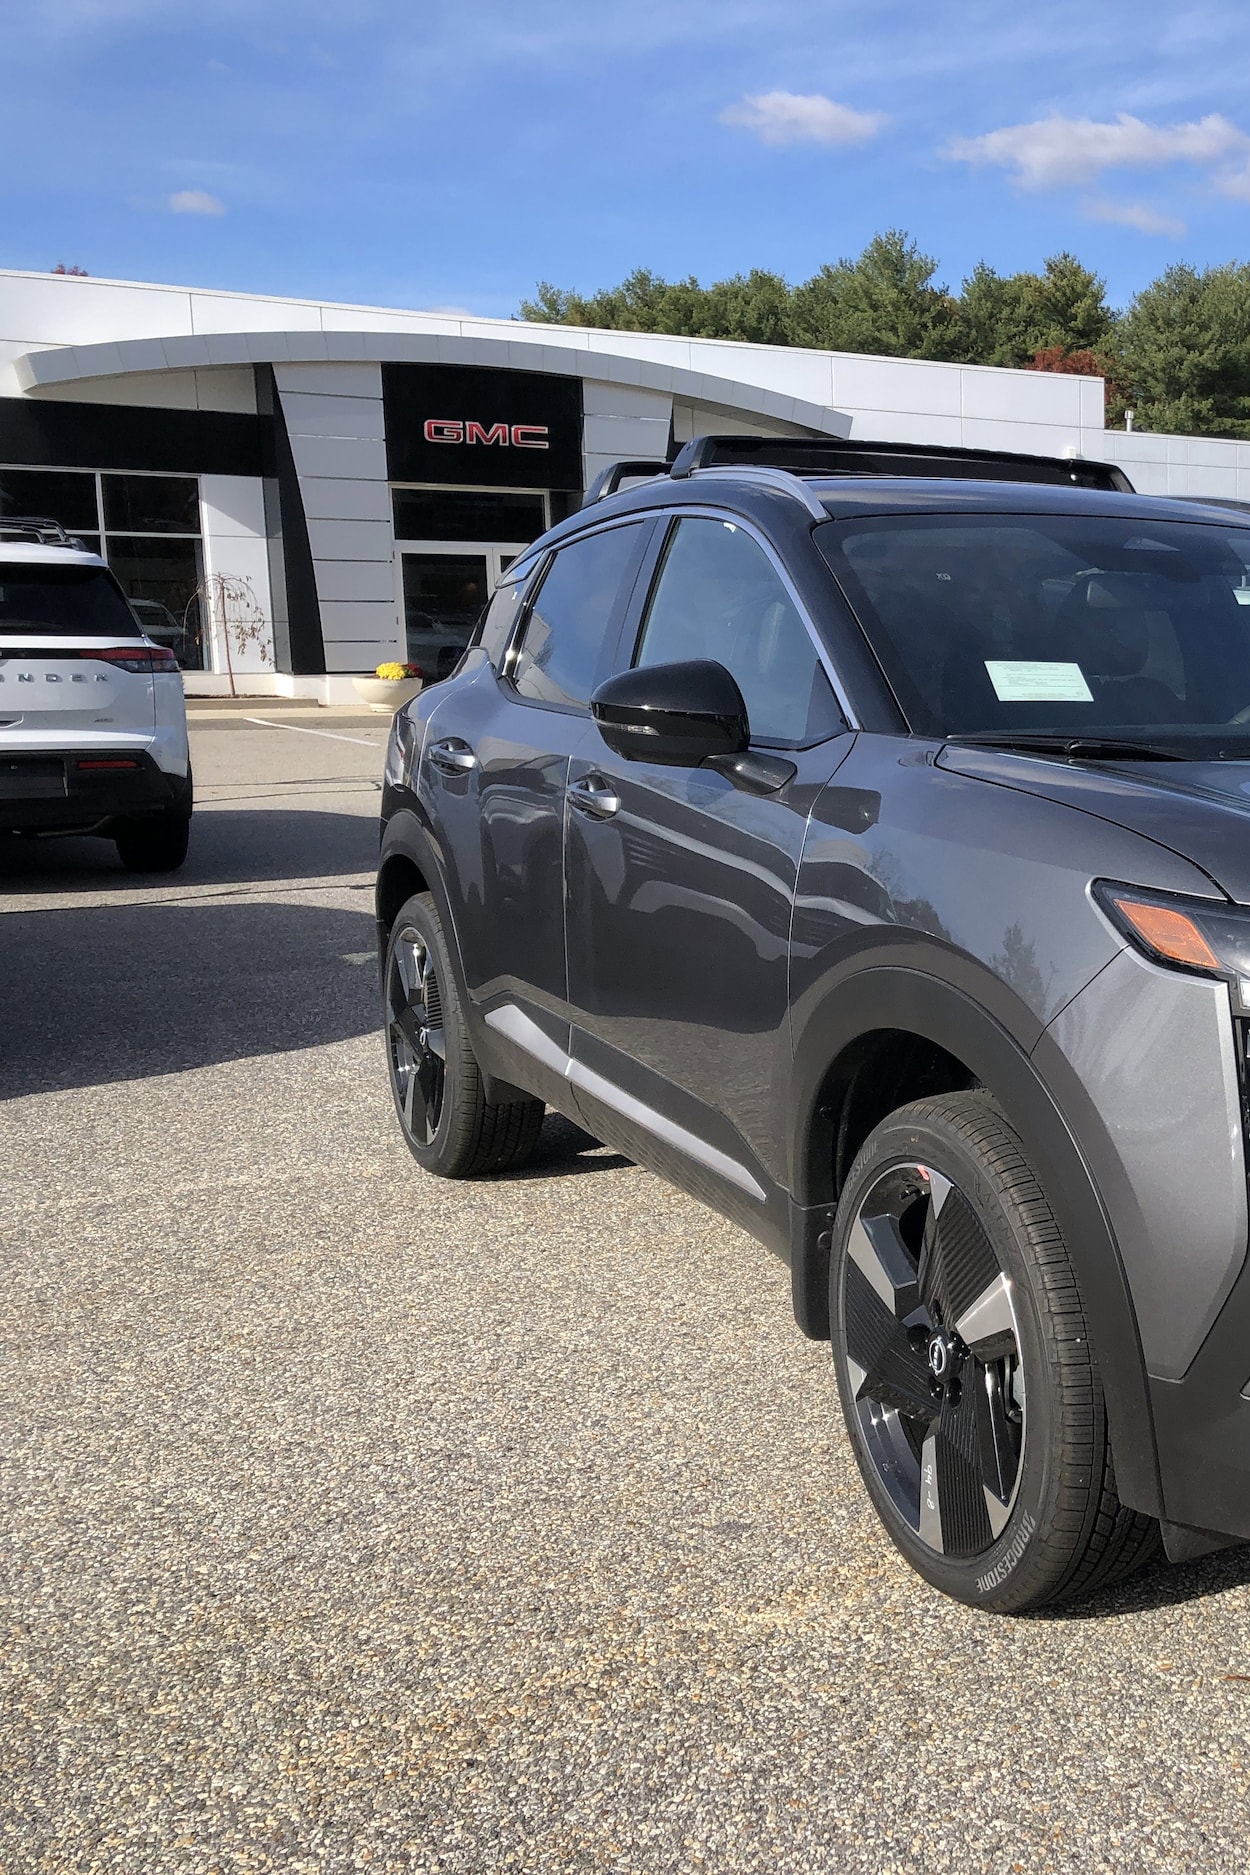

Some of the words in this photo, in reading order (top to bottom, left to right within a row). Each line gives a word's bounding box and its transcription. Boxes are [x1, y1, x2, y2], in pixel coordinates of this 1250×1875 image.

[424, 419, 549, 449] GMC
[0, 673, 109, 683] NDER
[975, 1509, 1036, 1594] BRIDGESTONE
